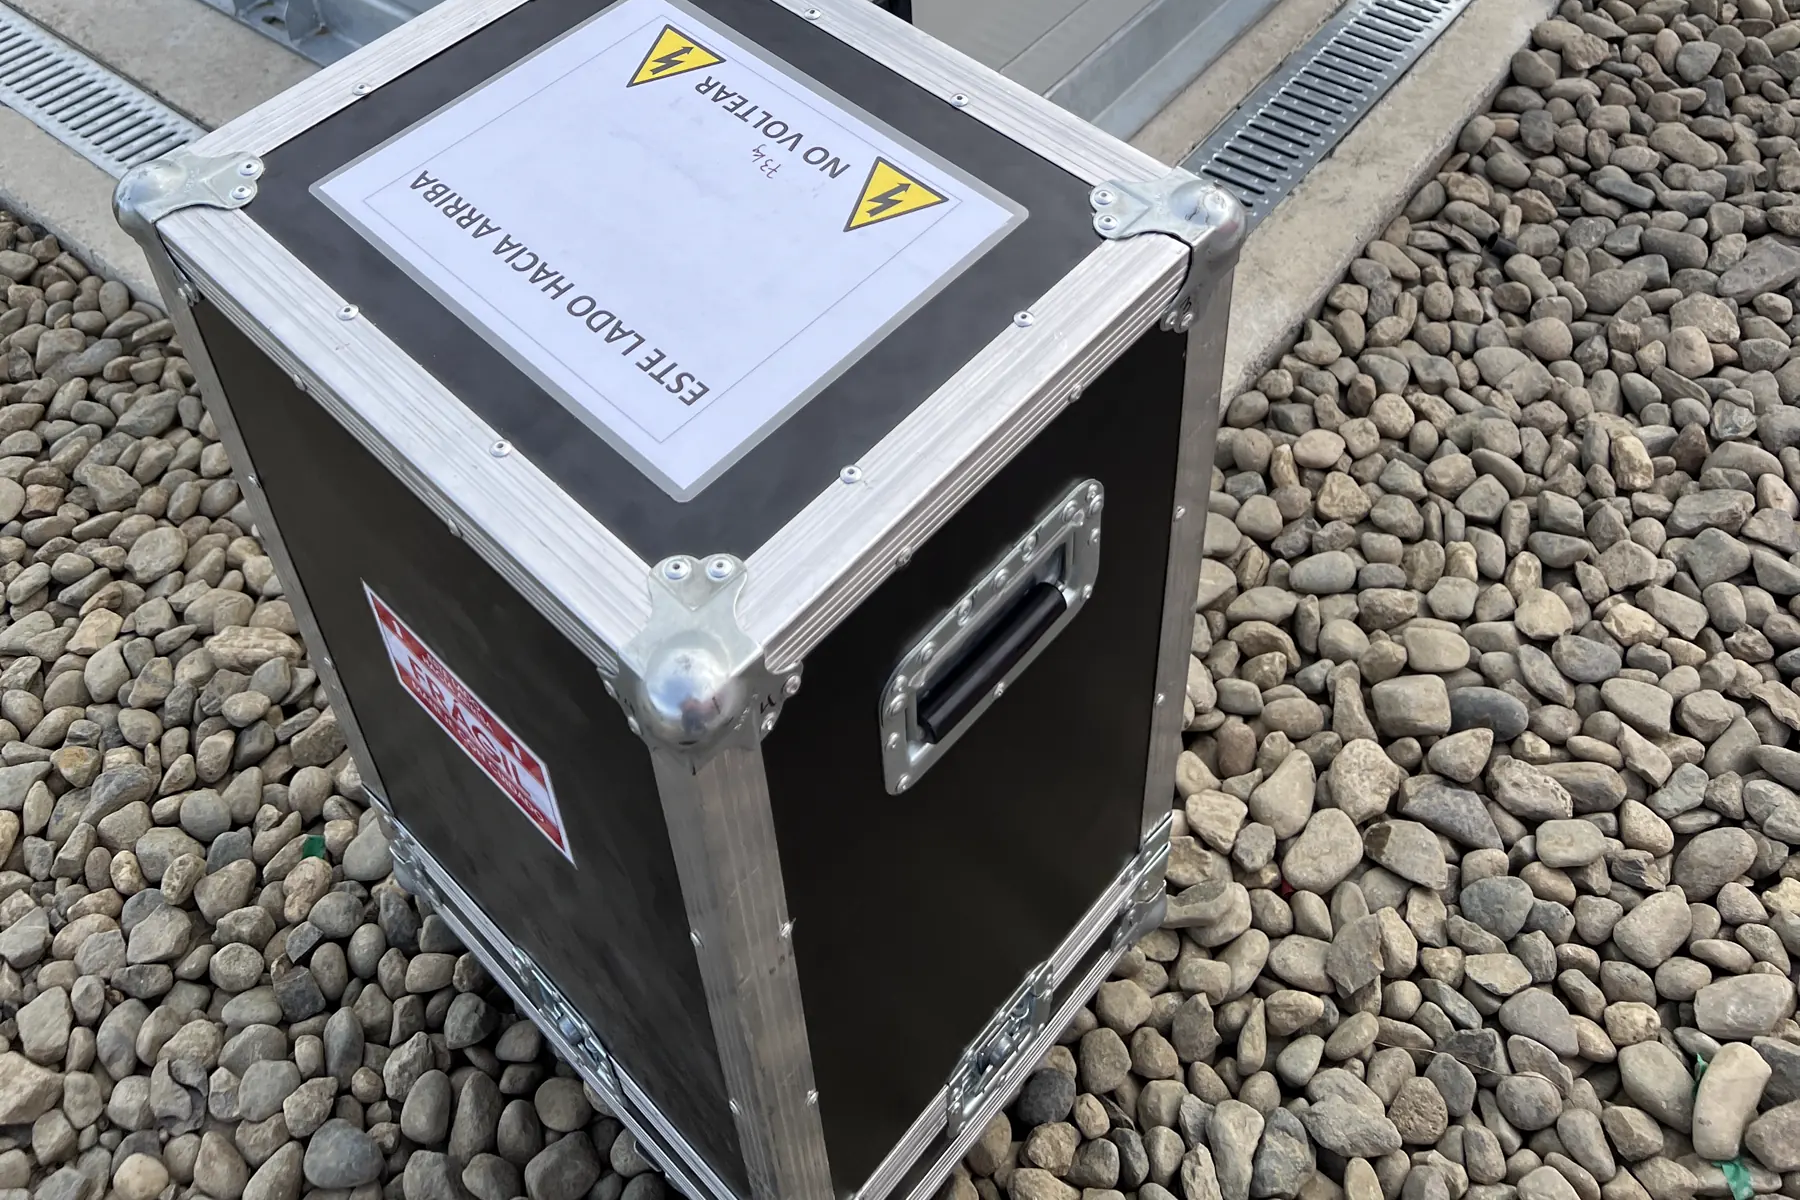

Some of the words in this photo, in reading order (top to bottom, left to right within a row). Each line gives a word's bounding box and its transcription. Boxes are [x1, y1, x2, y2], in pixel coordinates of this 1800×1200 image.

[695, 76, 803, 152] VOLTEAR
[802, 146, 851, 179] NO
[410, 170, 502, 238] ARRIBA
[492, 233, 575, 300] HACIA
[566, 295, 646, 356] LADO
[635, 348, 710, 406] ESTE
[488, 760, 544, 823] CUIDADO
